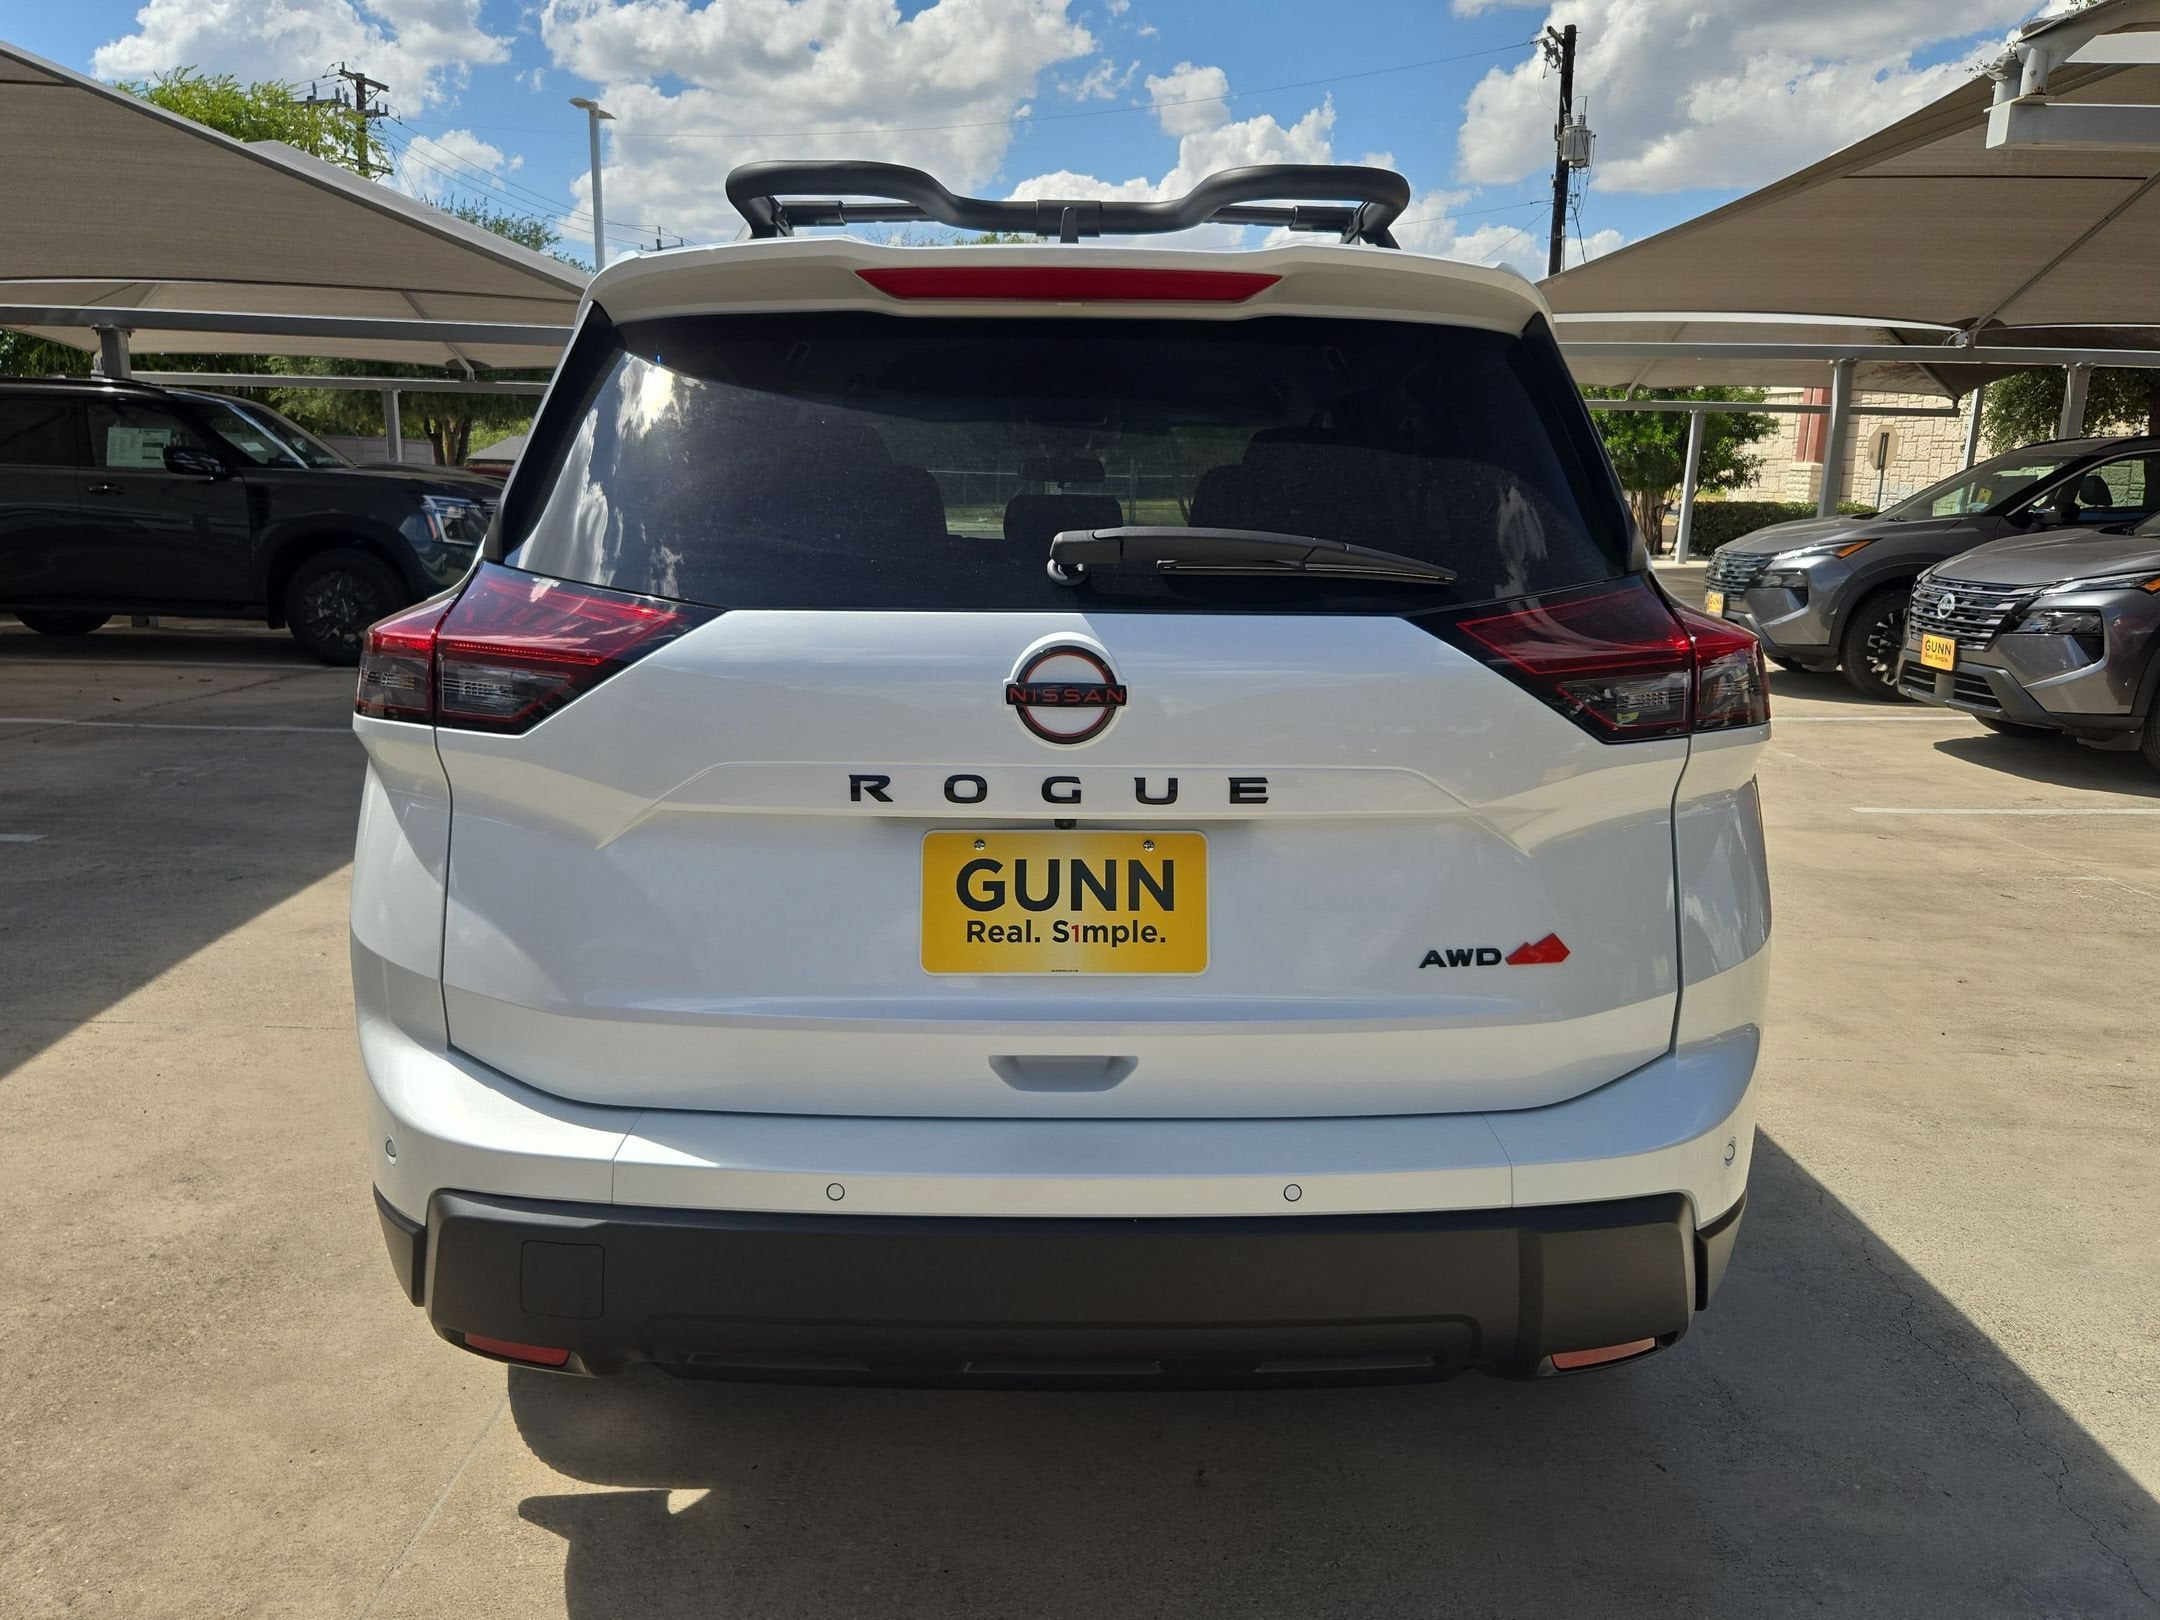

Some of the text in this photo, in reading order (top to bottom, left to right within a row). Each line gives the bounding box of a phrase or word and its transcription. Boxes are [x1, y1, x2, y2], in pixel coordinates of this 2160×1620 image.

[1925, 639, 1952, 656] GUNN
[1008, 687, 1125, 704] NISSAN
[848, 774, 1270, 805] ROGUE
[955, 858, 1175, 912] GUNN
[966, 919, 1041, 943] Real.
[1418, 947, 1502, 969] AWD
